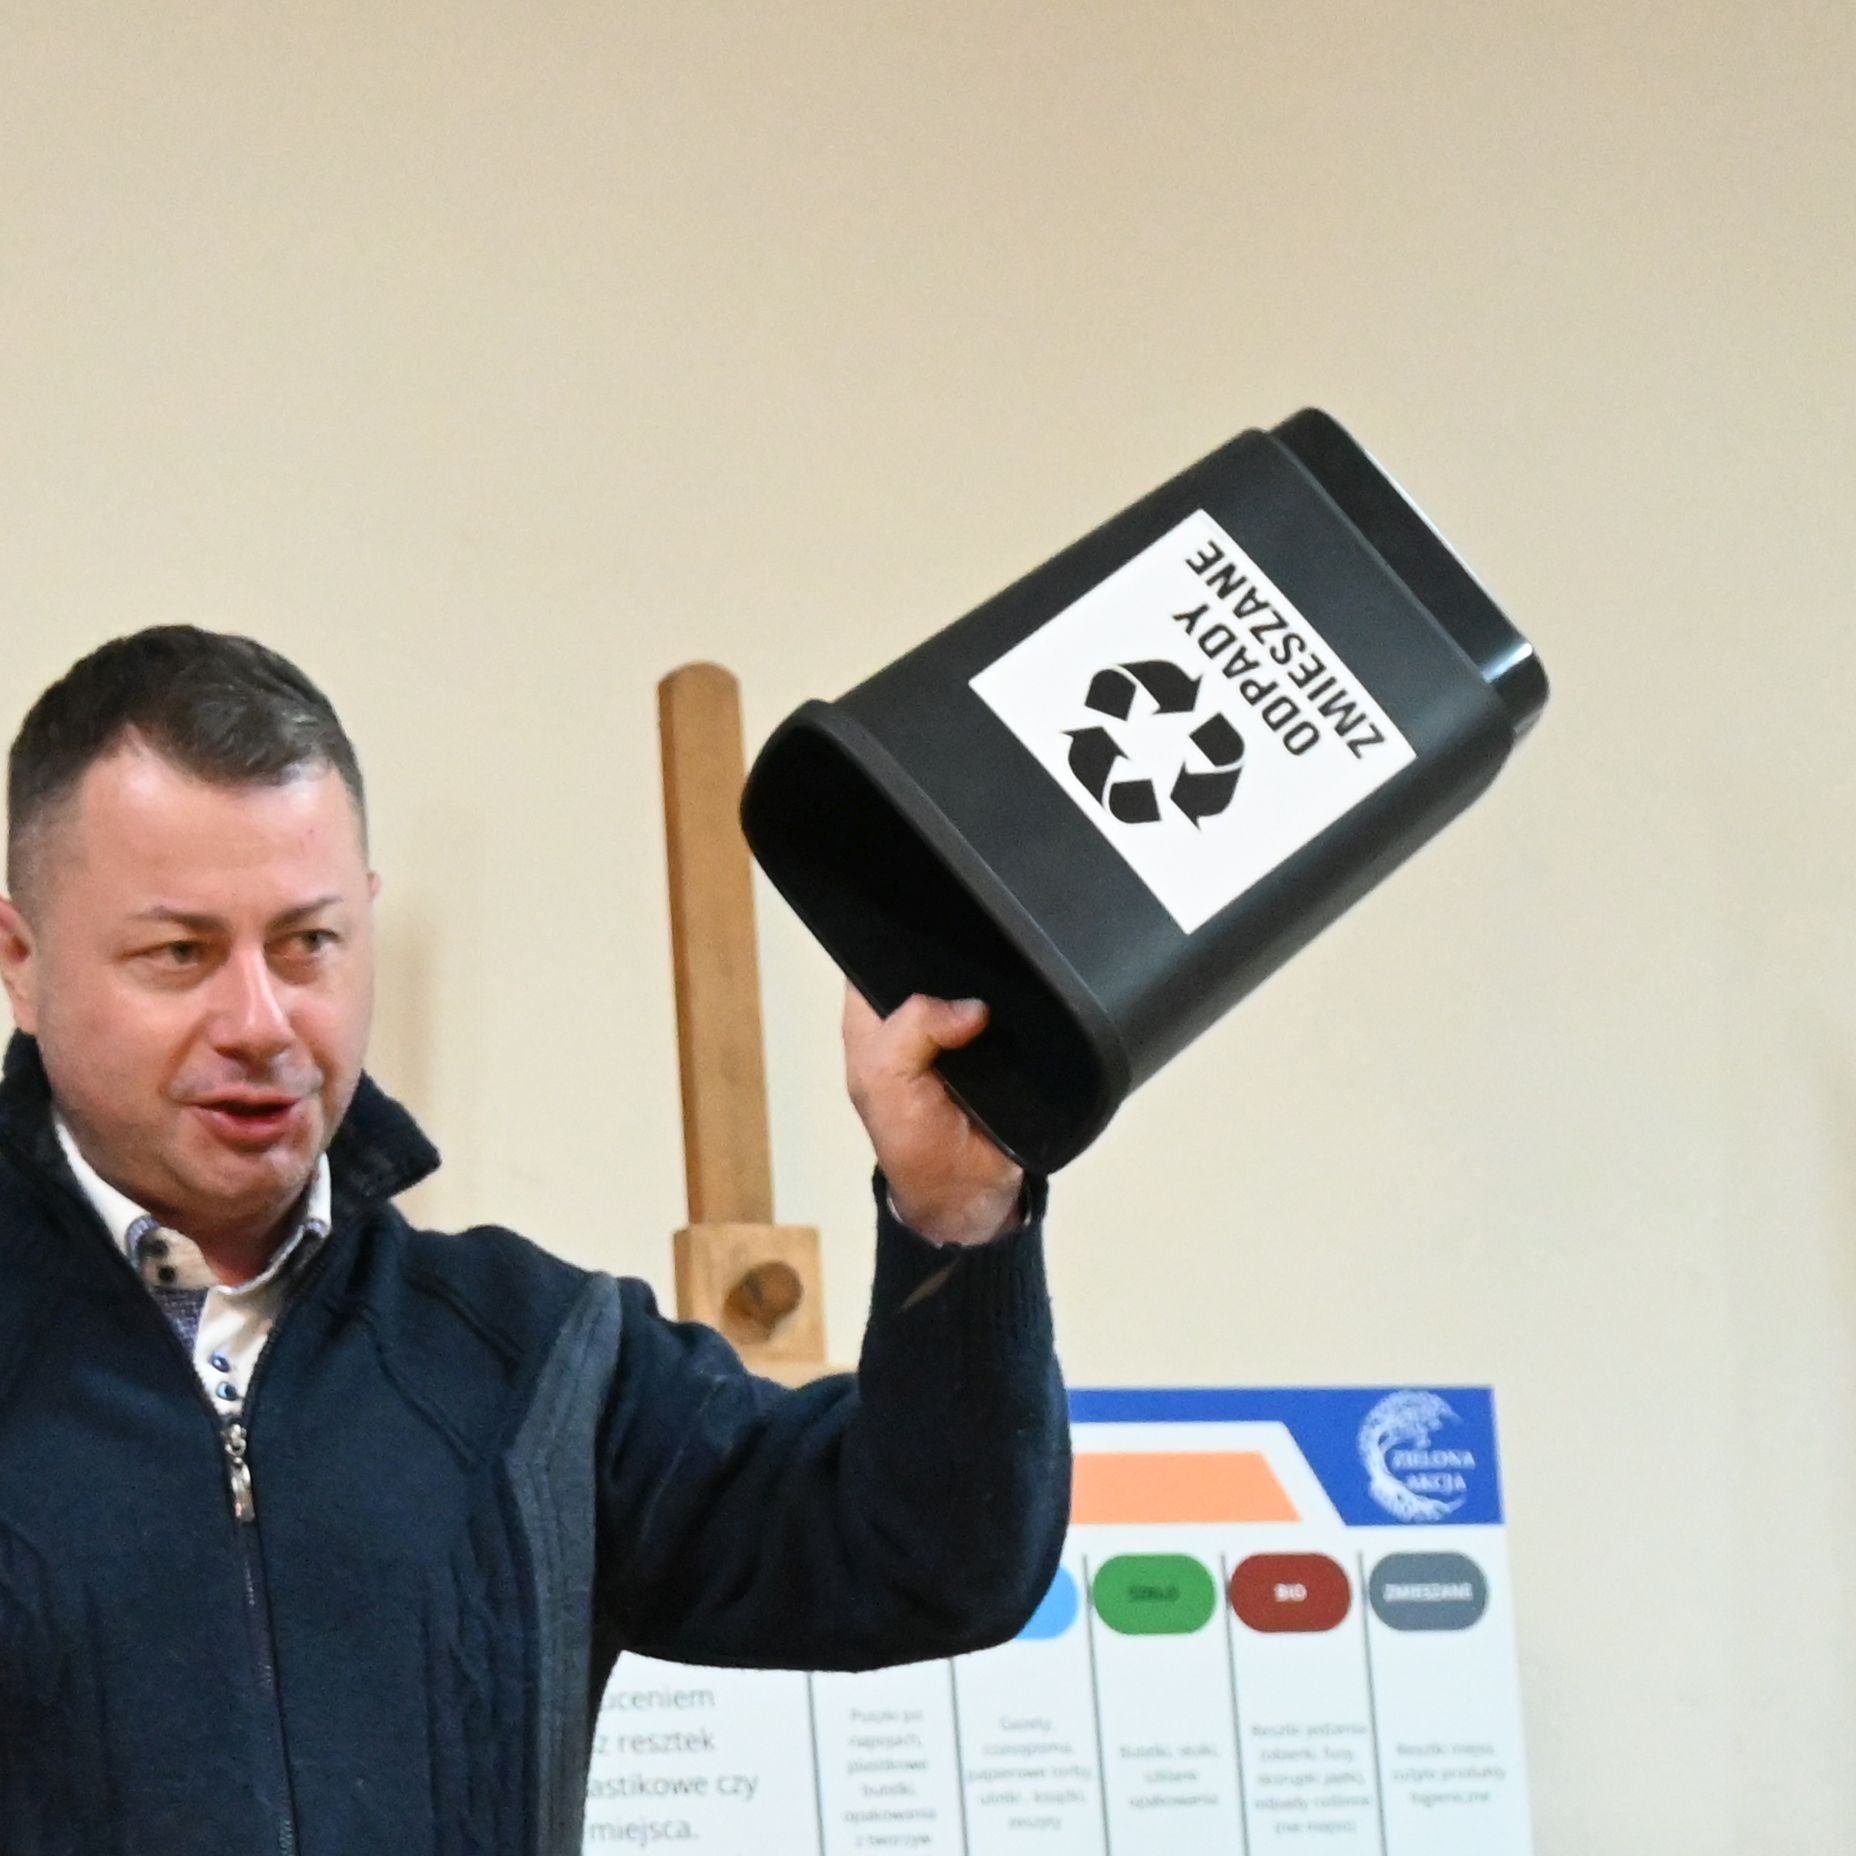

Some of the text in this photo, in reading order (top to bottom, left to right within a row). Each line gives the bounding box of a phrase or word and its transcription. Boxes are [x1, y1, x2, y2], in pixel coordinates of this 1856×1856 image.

[1185, 540, 1385, 760] ZMIESZANE
[1172, 604, 1320, 757] ODPADY
[1273, 1582, 1307, 1602] BIO
[618, 1727, 716, 1753] resztek
[717, 1773, 758, 1802] czy
[590, 1817, 699, 1847] miejsca.
